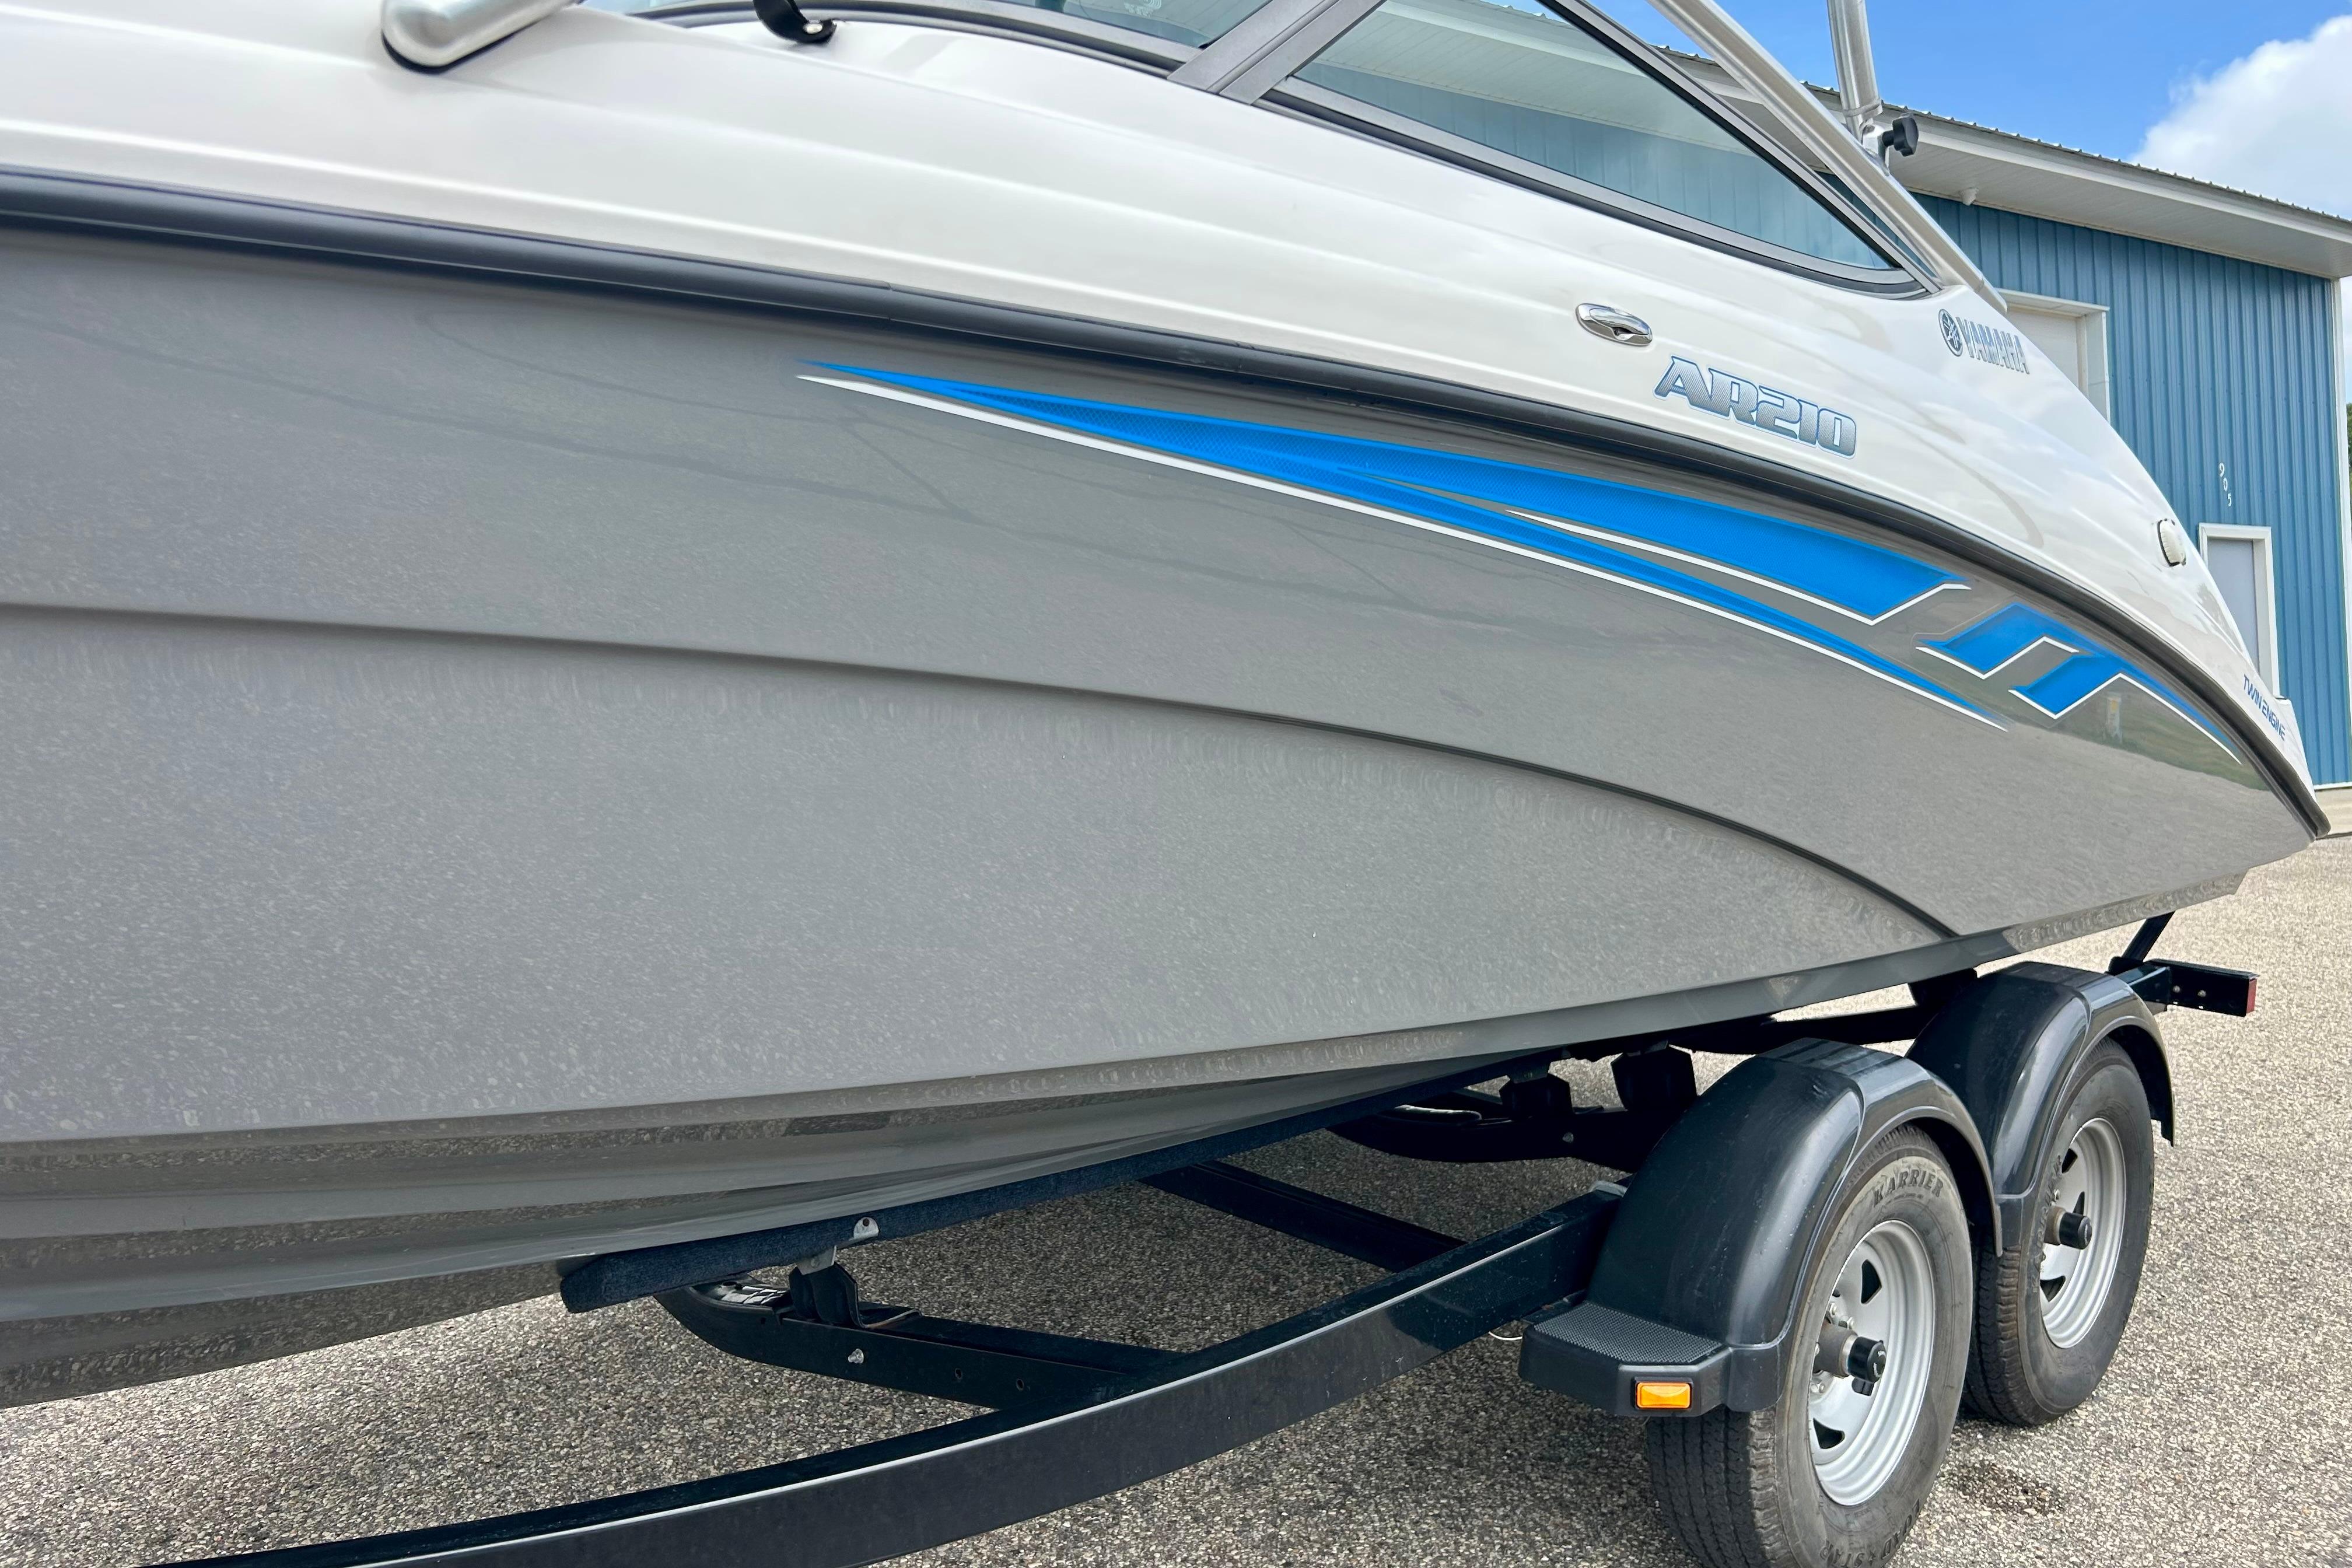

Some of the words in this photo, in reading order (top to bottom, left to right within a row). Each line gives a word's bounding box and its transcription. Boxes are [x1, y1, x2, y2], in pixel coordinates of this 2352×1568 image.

[1955, 316, 2029, 374] YAMAHA
[1653, 355, 1857, 457] AR210
[2244, 673, 2262, 709] TWIN
[2262, 699, 2286, 741] ENGINE
[1873, 1168, 1944, 1208] KARRIER
